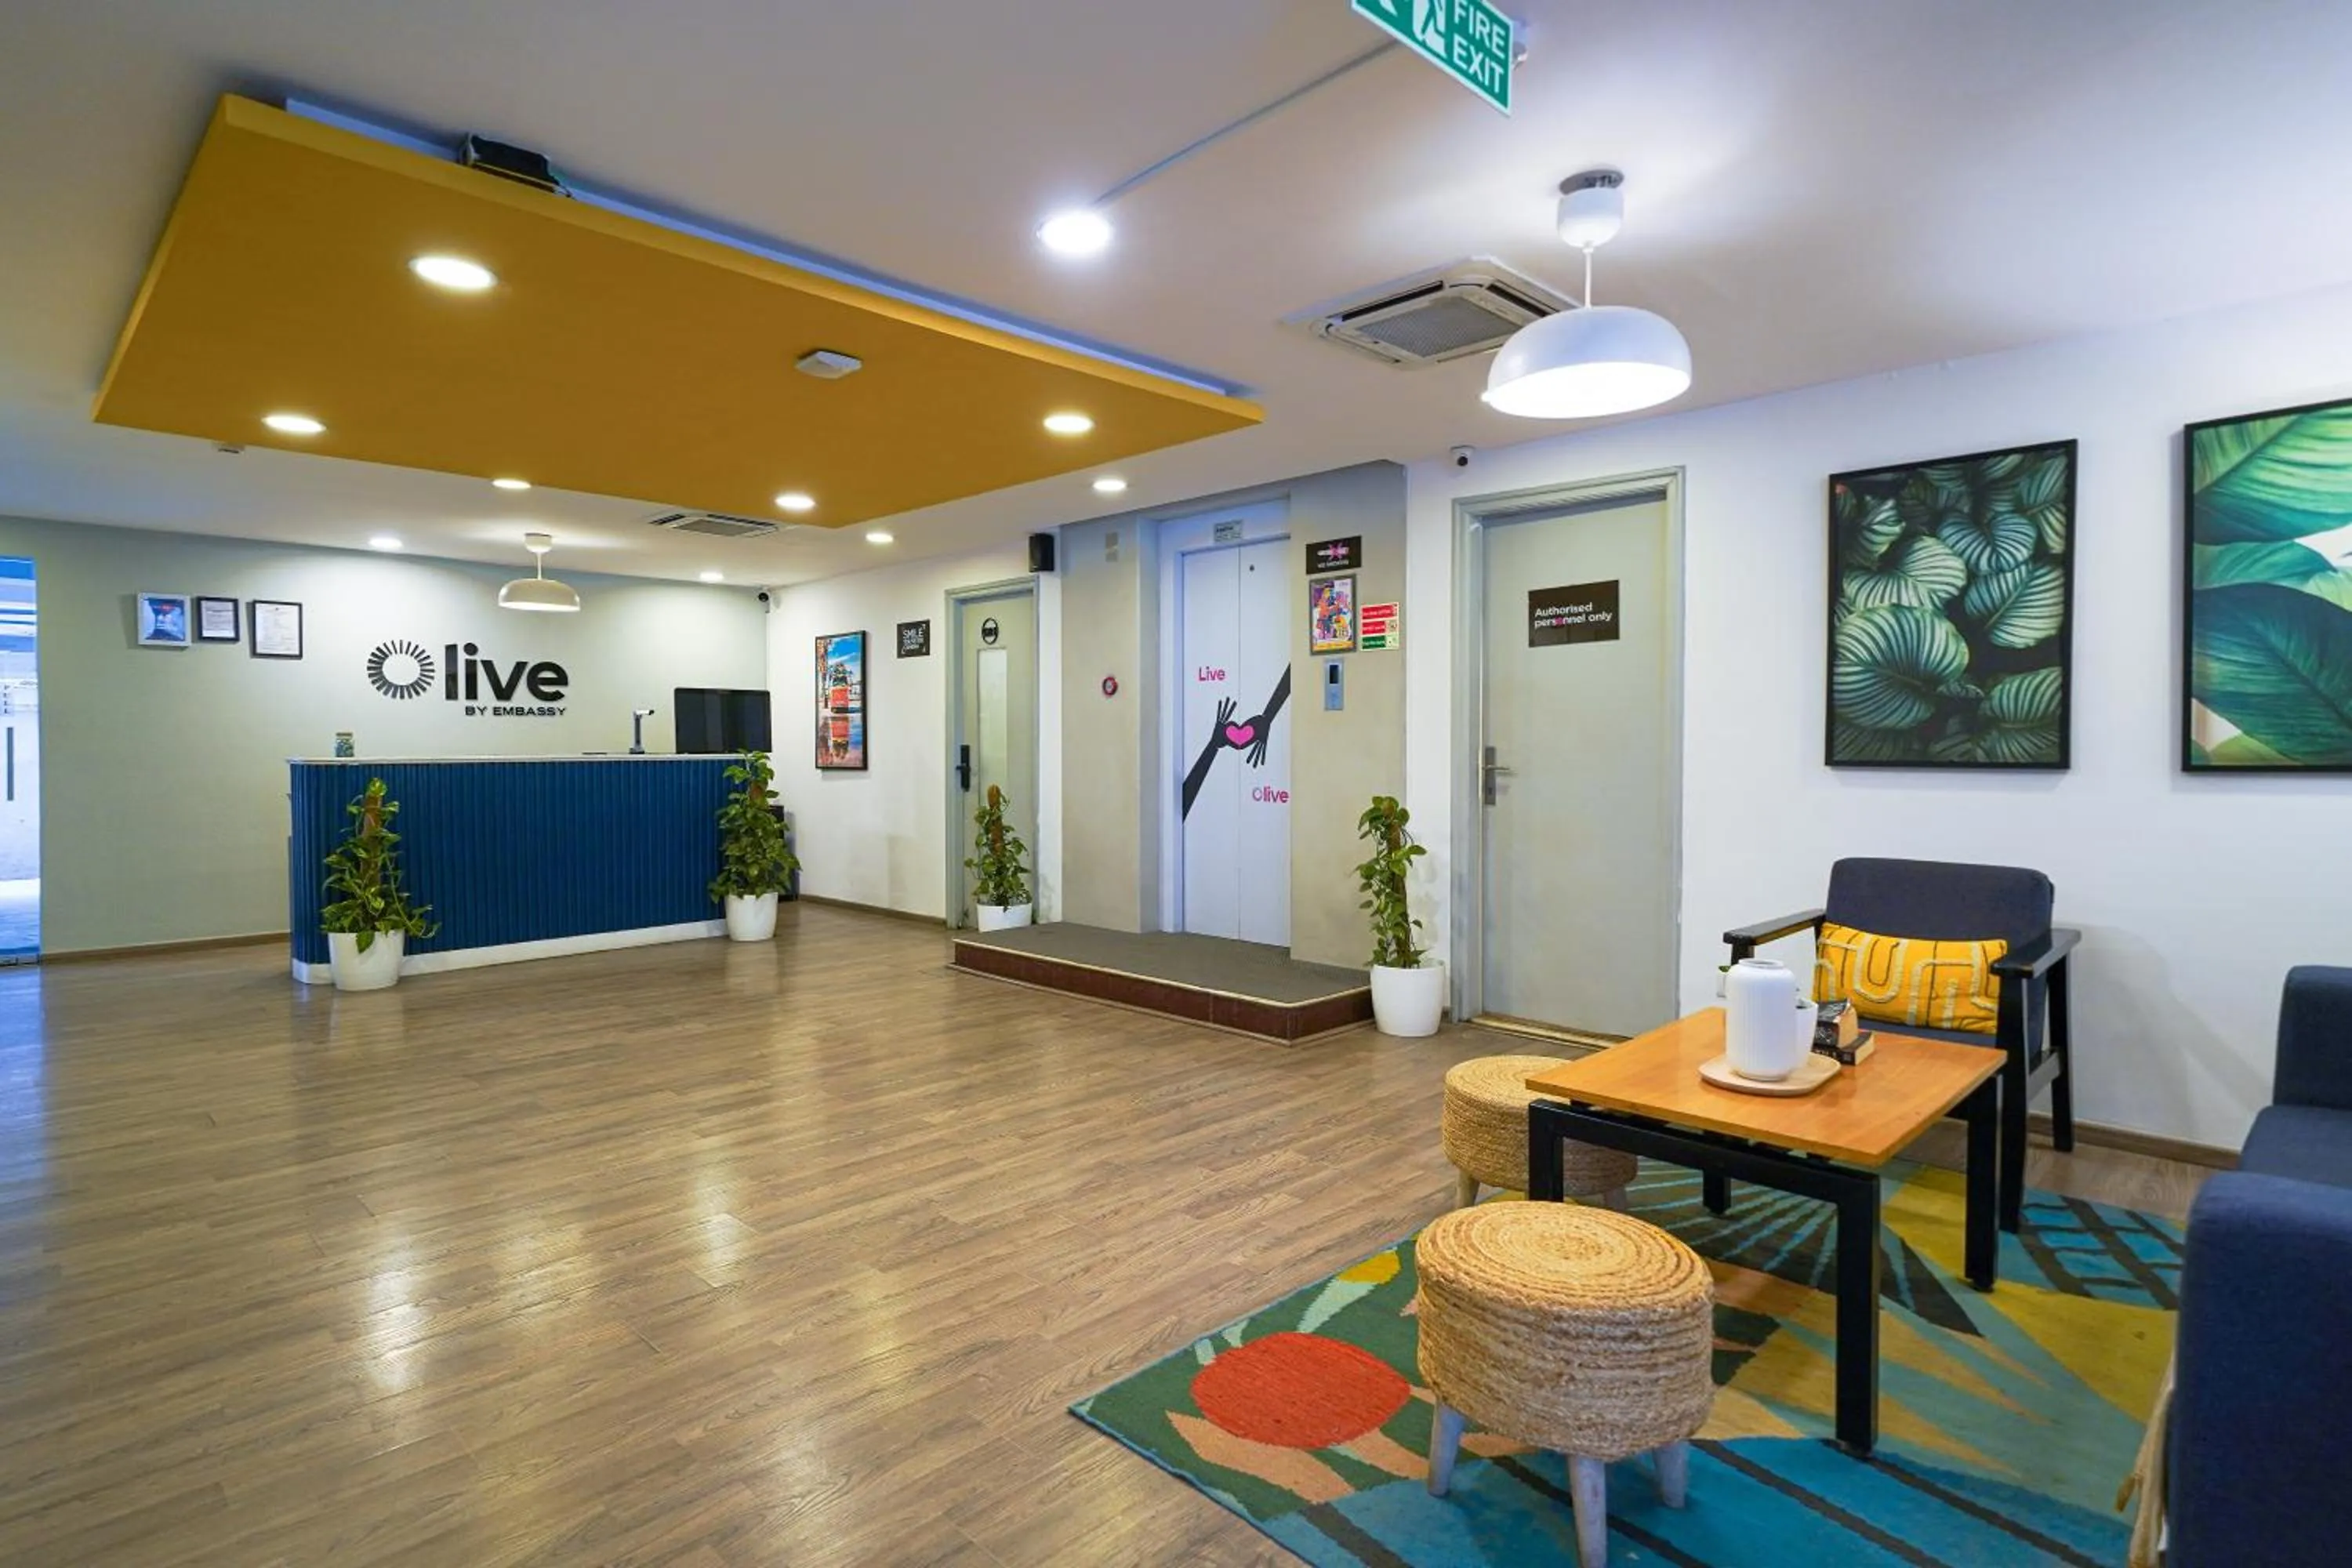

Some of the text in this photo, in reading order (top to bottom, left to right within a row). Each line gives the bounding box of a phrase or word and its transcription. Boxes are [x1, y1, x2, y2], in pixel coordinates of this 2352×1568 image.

[1454, 0, 1505, 60] FIRE
[1454, 33, 1504, 93] EXIT
[1534, 601, 1593, 618] Authorised
[1534, 611, 1613, 630] personnel only
[1199, 666, 1225, 681] Live
[465, 706, 567, 717] BY EMBASSY
[1252, 786, 1289, 804] Olive
